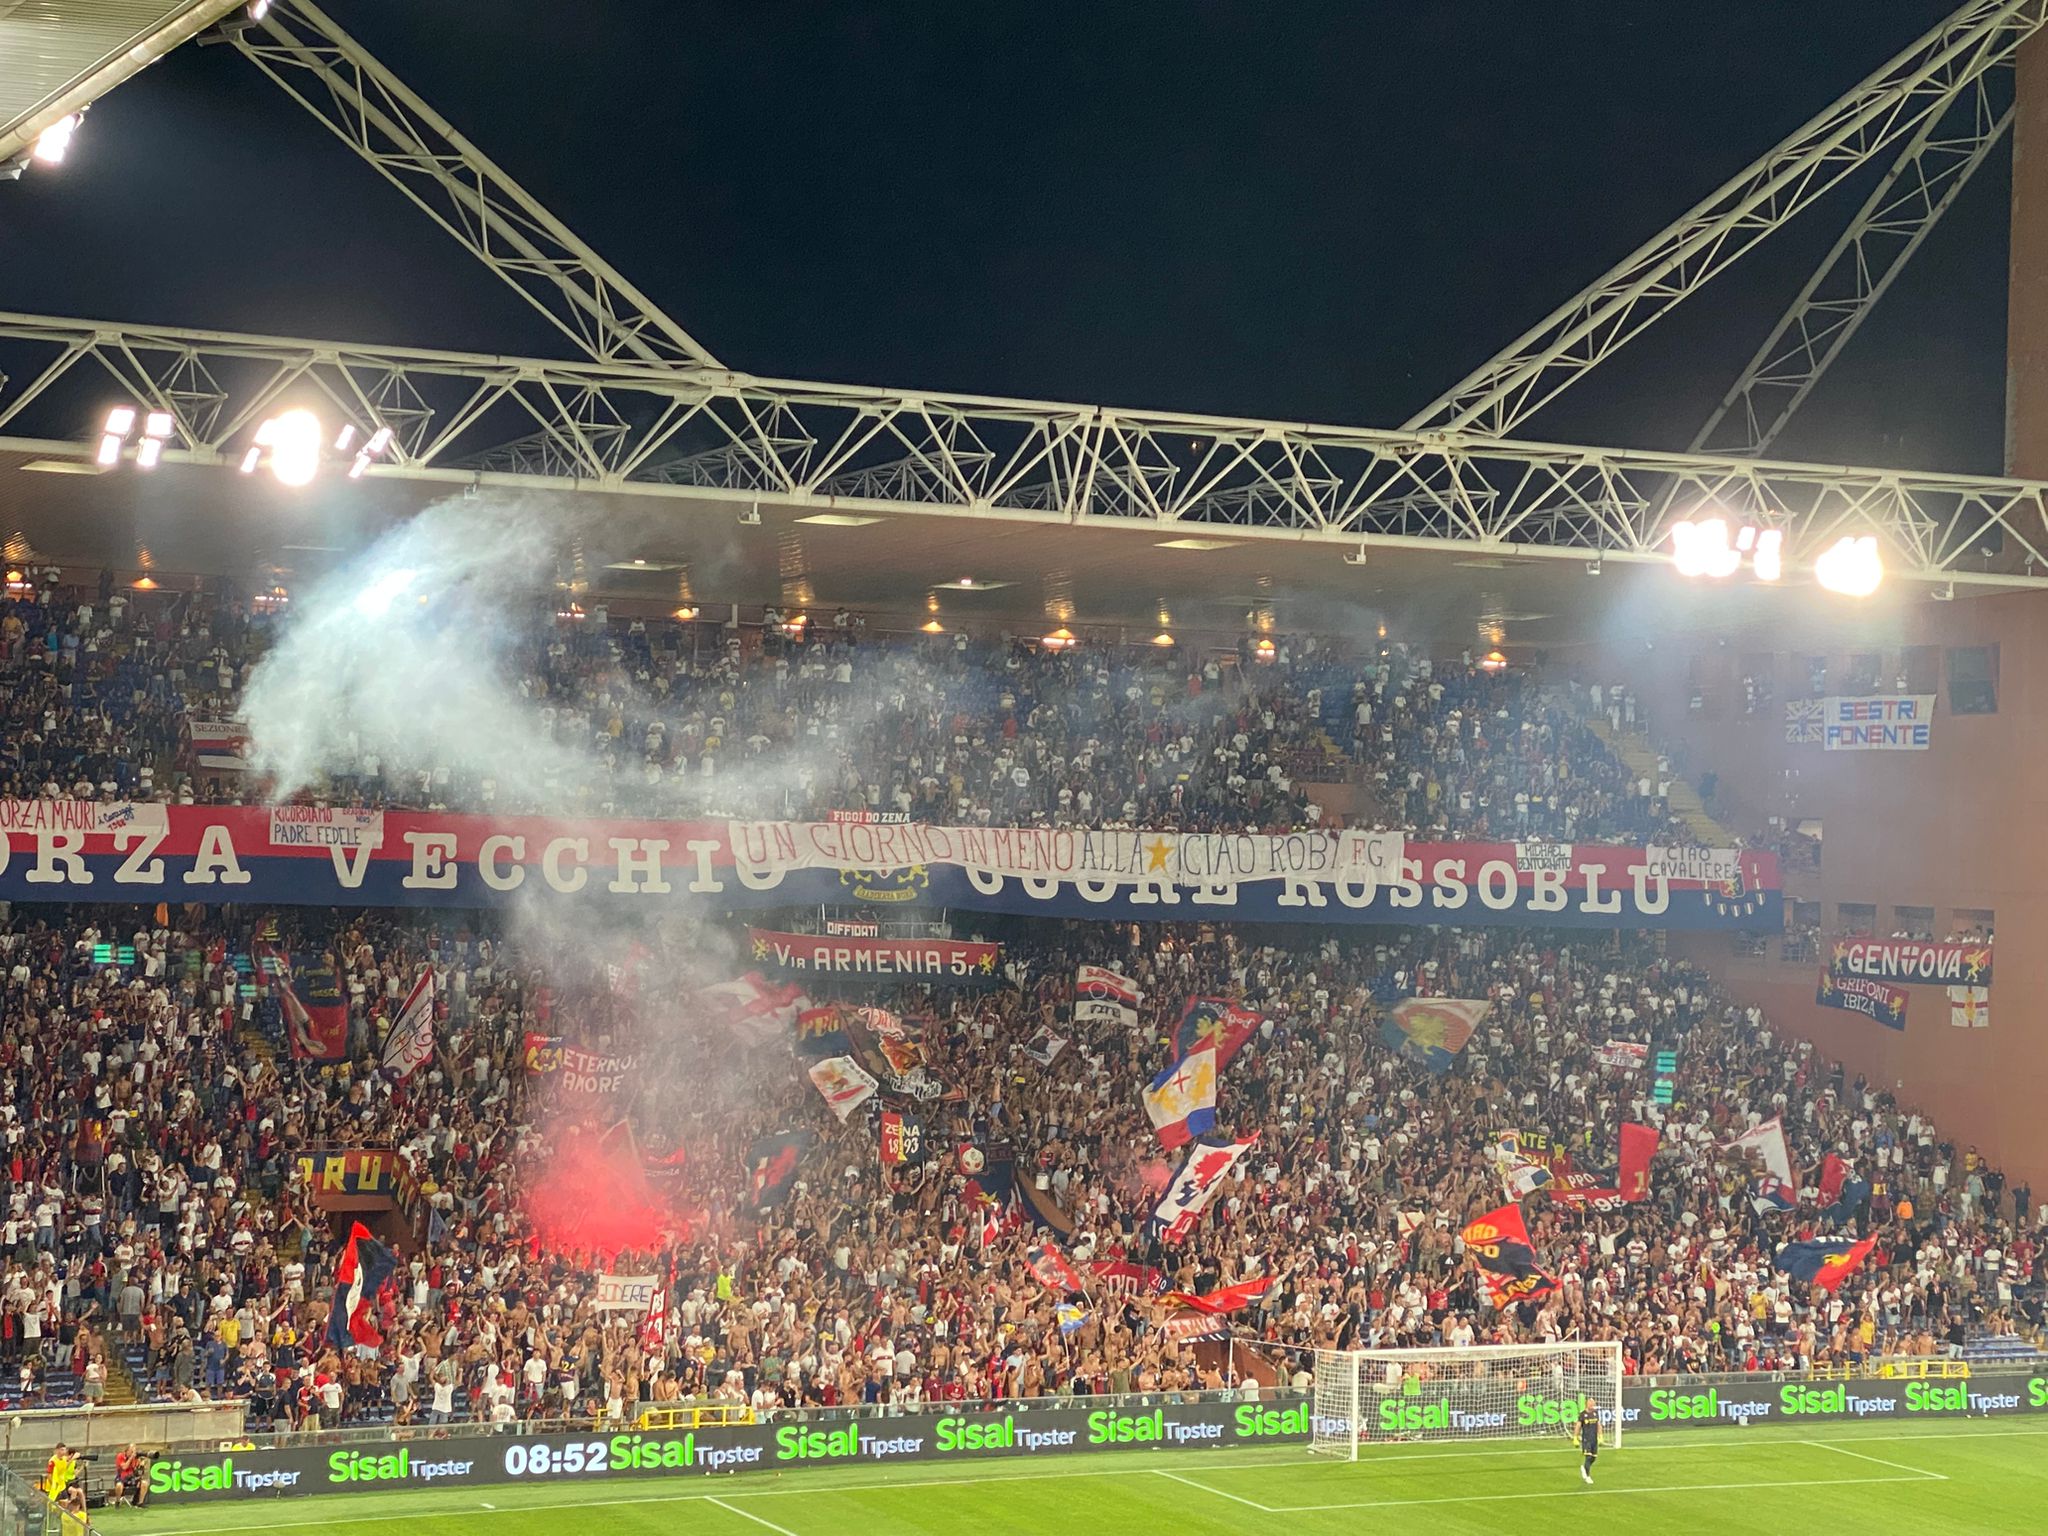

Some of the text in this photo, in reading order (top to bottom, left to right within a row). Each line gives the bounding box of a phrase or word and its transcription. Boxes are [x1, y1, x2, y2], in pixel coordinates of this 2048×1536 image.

[1839, 700, 1918, 720] SESTRI
[1827, 724, 1929, 745] PONENTE
[274, 807, 332, 822] RICORDIAMO
[881, 812, 911, 823] ZENA
[274, 824, 362, 845] PADRE FEDELE
[742, 822, 797, 863] UN
[810, 822, 953, 863] GIORNO
[958, 829, 987, 866] IN
[992, 829, 1074, 871] MENO
[1081, 832, 1145, 874] ALLA
[1183, 834, 1255, 876] CIAO
[1525, 844, 1566, 858] MICHAEL
[1667, 847, 1711, 861] CIAO
[1650, 862, 1733, 879] CAVALIERE
[827, 921, 878, 937] DIFFIDATI
[814, 948, 942, 974] ARMENIA
[1837, 977, 1890, 1004] GRIFONI
[1843, 993, 1876, 1016] IBIZA
[562, 1071, 625, 1093] AMORE
[885, 1123, 920, 1136] ZENA
[888, 1138, 919, 1154] 1893
[1650, 1388, 1772, 1421] Sisal Tipster
[1781, 1384, 1897, 1416] Sisal Tipster
[1905, 1382, 2020, 1413] Sisal Tipster
[2027, 1377, 2048, 1407] S
[1088, 1409, 1224, 1444] Sisal Tipster
[1235, 1402, 1308, 1437] Sisal
[1380, 1398, 1507, 1431] Sisal Tipster
[776, 1423, 924, 1461] Sisal Tipster
[936, 1415, 1077, 1452] Sisal Tipster
[505, 1442, 608, 1475] 08:52
[610, 1433, 763, 1470] Sisal Tipster
[150, 1458, 300, 1494] Sisal Tipster
[328, 1448, 474, 1483] Sisal Tipster
